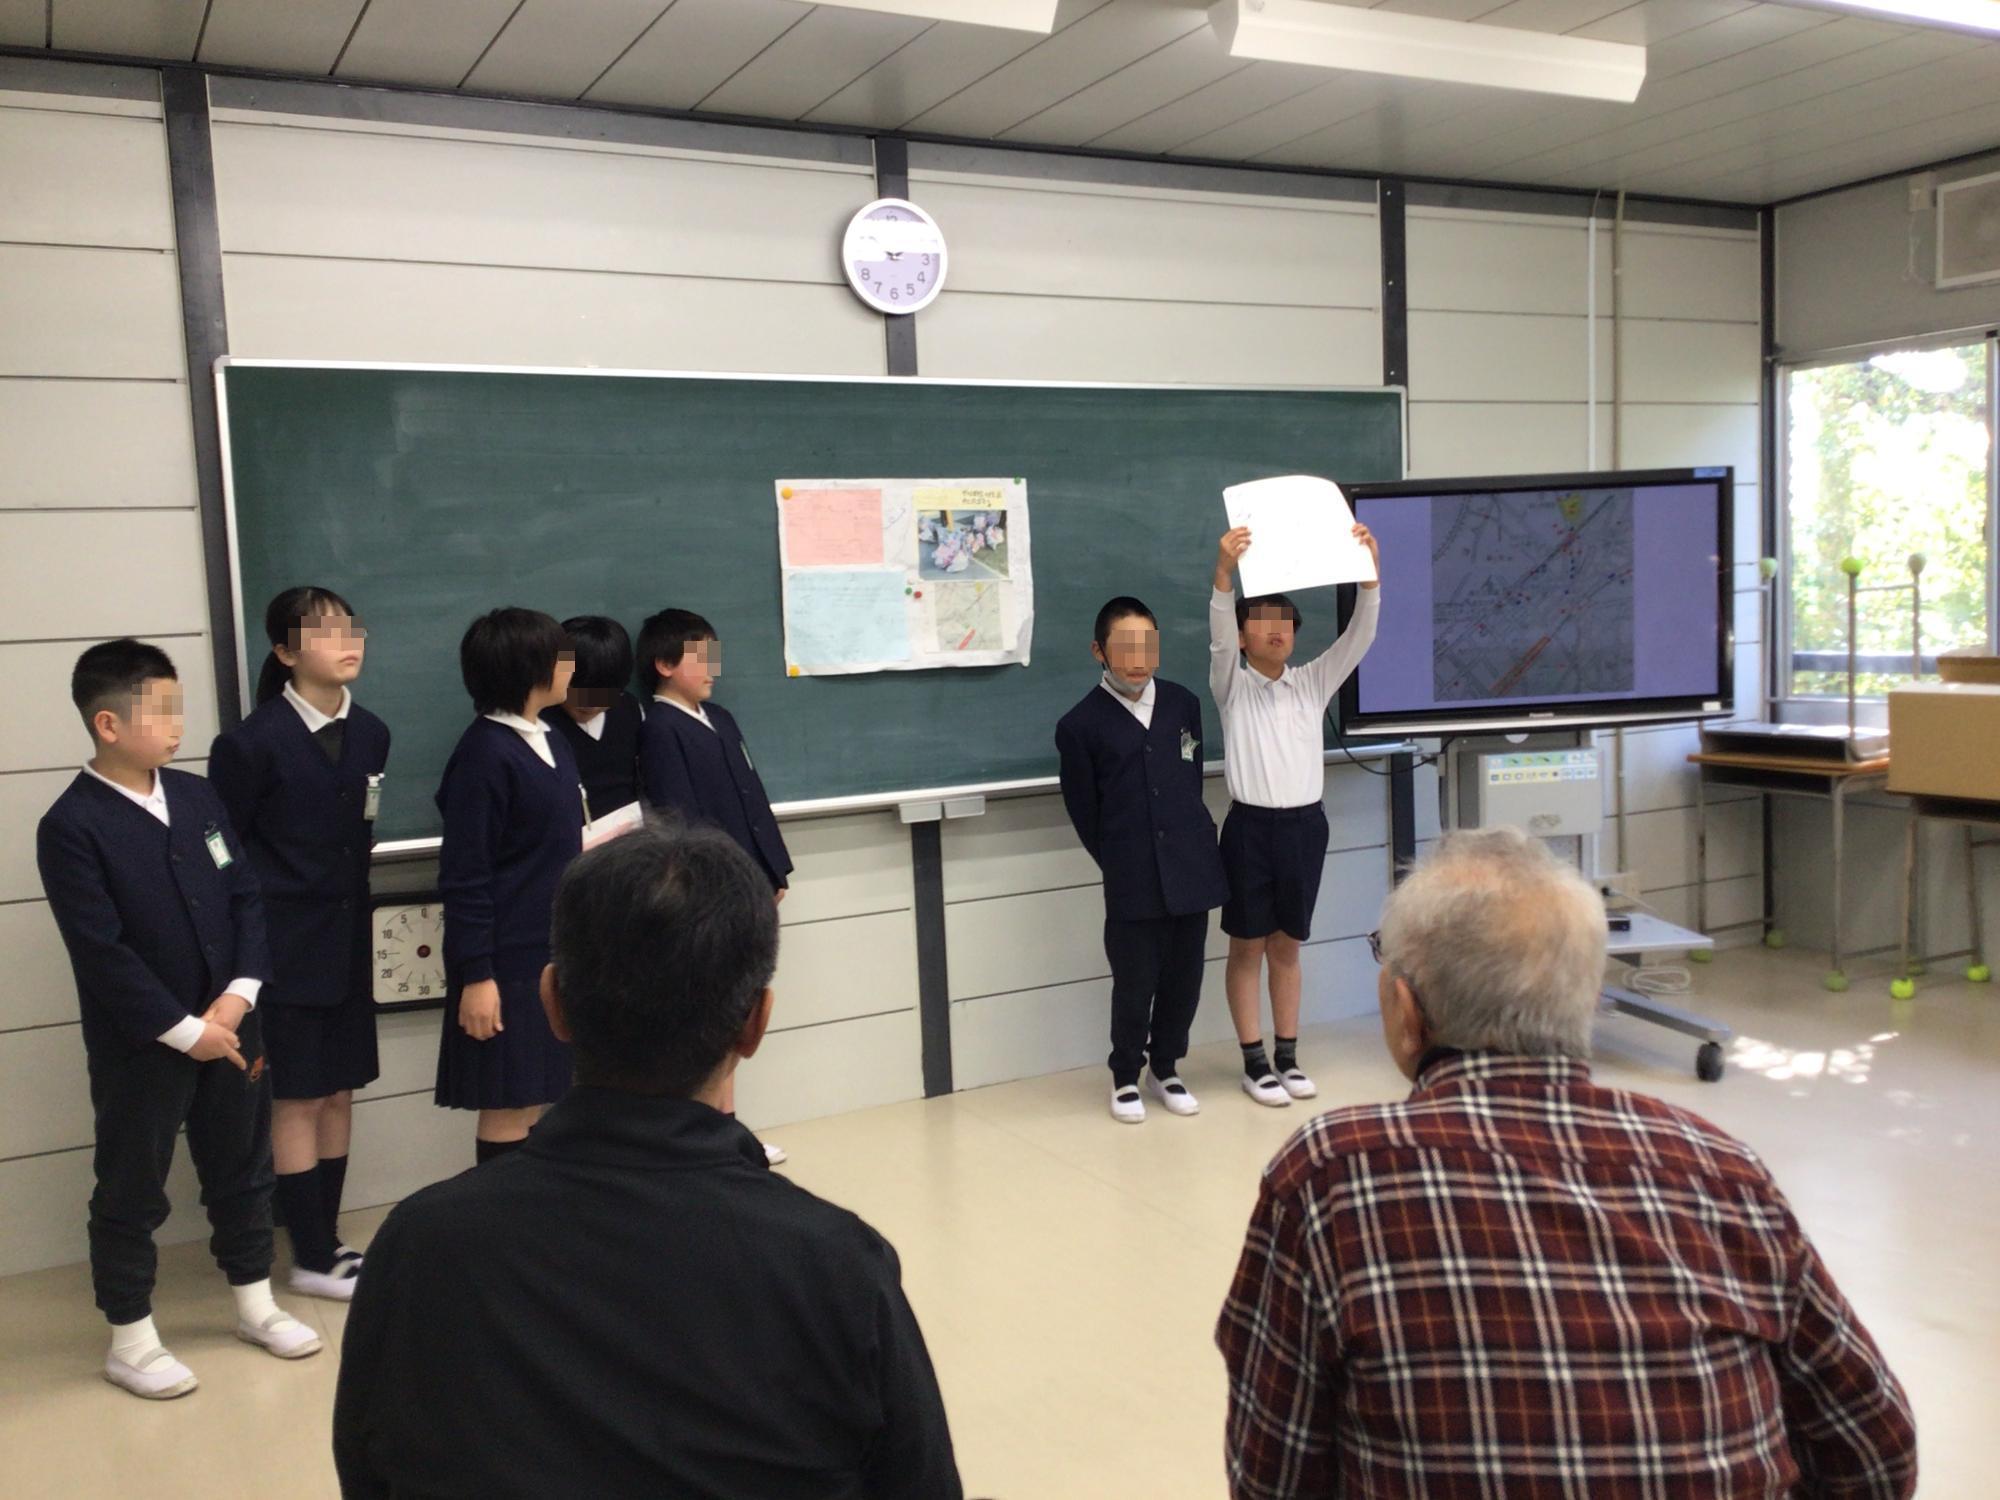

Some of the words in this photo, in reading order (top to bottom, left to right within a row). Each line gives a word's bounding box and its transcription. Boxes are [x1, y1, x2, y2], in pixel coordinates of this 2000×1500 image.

[921, 253, 930, 265] 3
[861, 268, 870, 281] 8
[917, 271, 926, 283] 4
[874, 282, 882, 293] 7
[890, 287, 899, 299] 6
[906, 283, 915, 296] 5
[401, 914, 407, 924] 5
[382, 929, 393, 939] 10
[376, 949, 388, 960] 15
[381, 968, 393, 979] 20
[398, 982, 409, 993] 25
[418, 985, 430, 995] 30
